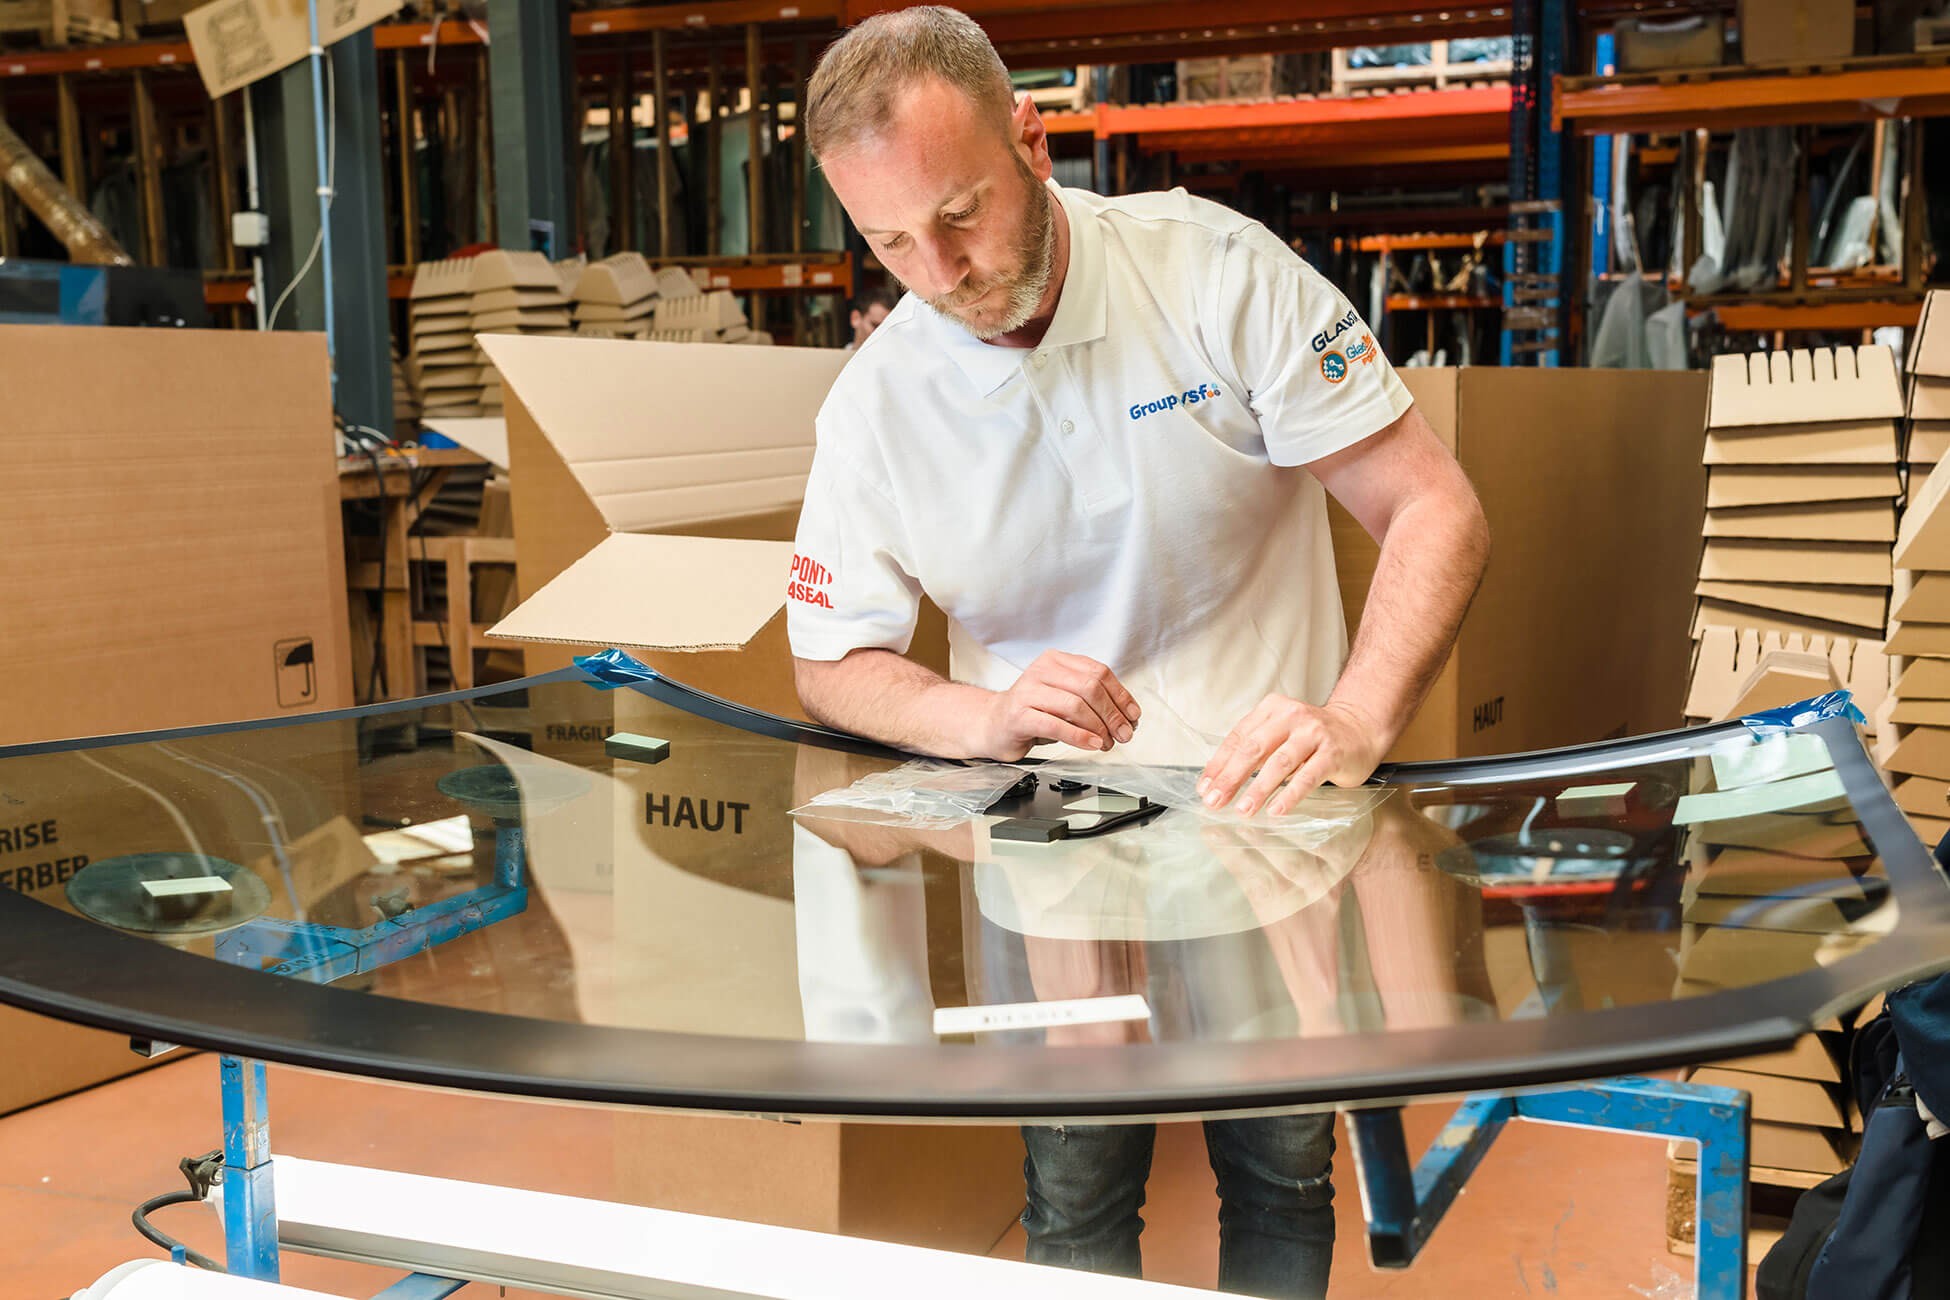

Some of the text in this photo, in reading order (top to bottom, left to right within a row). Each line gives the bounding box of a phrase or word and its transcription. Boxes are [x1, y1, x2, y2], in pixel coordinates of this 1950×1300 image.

[1473, 696, 1504, 733] HAUT
[646, 792, 750, 834] HAUT
[0, 819, 58, 853] RISE
